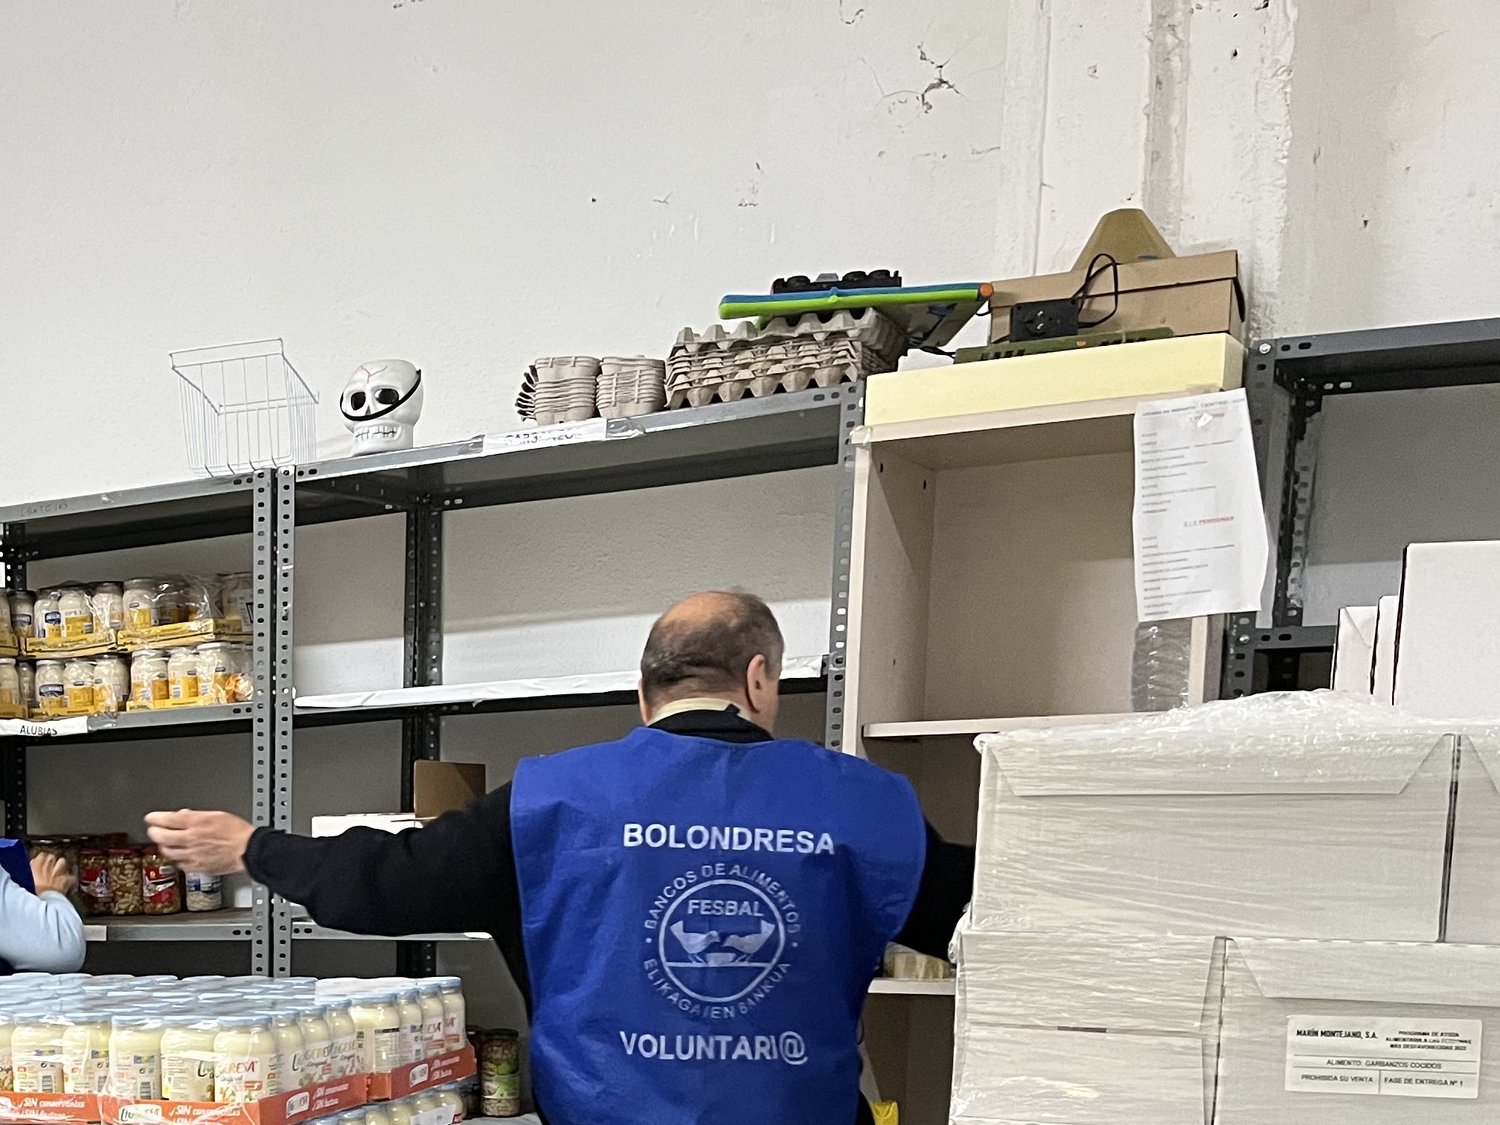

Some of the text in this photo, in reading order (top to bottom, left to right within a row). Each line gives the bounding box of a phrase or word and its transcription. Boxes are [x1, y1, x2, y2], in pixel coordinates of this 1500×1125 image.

[19, 724, 58, 736] ALUBIAS
[623, 823, 835, 855] BOLONDRESA
[644, 863, 802, 933] BANCOS DE ALIMENTOS
[687, 899, 764, 917] FESBAL
[643, 958, 792, 1020] ELIKAGAIEN BANKUA
[1320, 1030, 1364, 1039] MONTEJANO,
[1366, 1031, 1378, 1039] S.A.
[619, 1031, 808, 1066] VOLUNTARI@
[1301, 1074, 1338, 1082] PROHIBIDA
